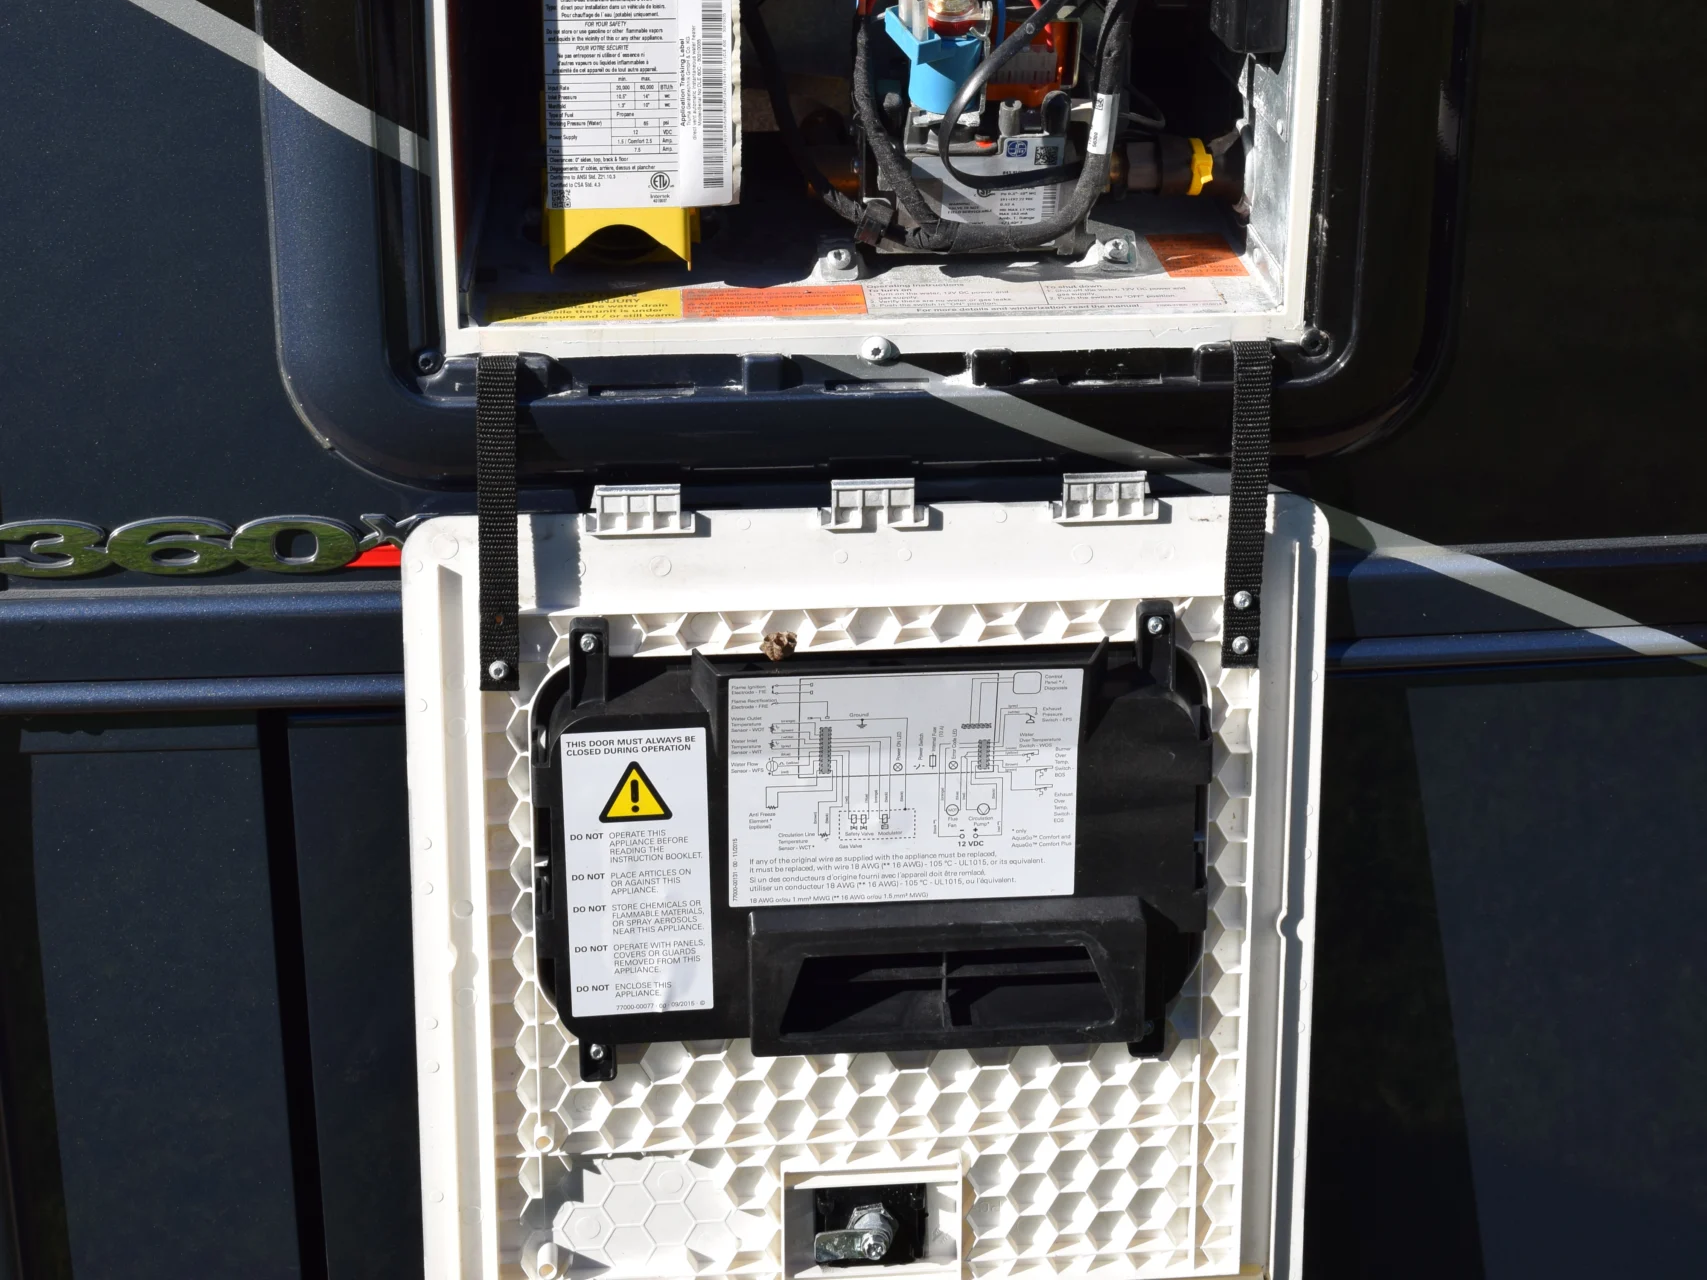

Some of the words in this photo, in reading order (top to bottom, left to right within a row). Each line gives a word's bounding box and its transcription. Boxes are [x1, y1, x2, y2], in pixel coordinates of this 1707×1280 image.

[641, 744, 690, 752] OPERATION
[609, 830, 645, 839] OPERATE
[609, 838, 654, 847] APPLIANCE
[610, 854, 663, 863] INSTRUCTION
[666, 852, 702, 860] BOOKLET.
[639, 869, 676, 877] ARTICLES
[625, 878, 660, 886] AGAINST
[611, 886, 658, 895] APPLIANCE.
[612, 903, 637, 911] STORE
[640, 901, 687, 909] CHEMICALS
[613, 910, 659, 919] FLAMMABLE
[661, 908, 704, 916] MATERIALS,
[654, 916, 697, 924] AEROSOLS
[658, 924, 704, 932] APPLIANCE.
[613, 942, 648, 951] OPERATE
[614, 951, 646, 959] COVERS
[662, 948, 698, 956] GUARDS
[614, 958, 654, 966] REMOVED
[614, 966, 661, 974] APPLIANCE.
[615, 982, 651, 990] ENCLOSE
[615, 989, 661, 998] APPLIANCE.
